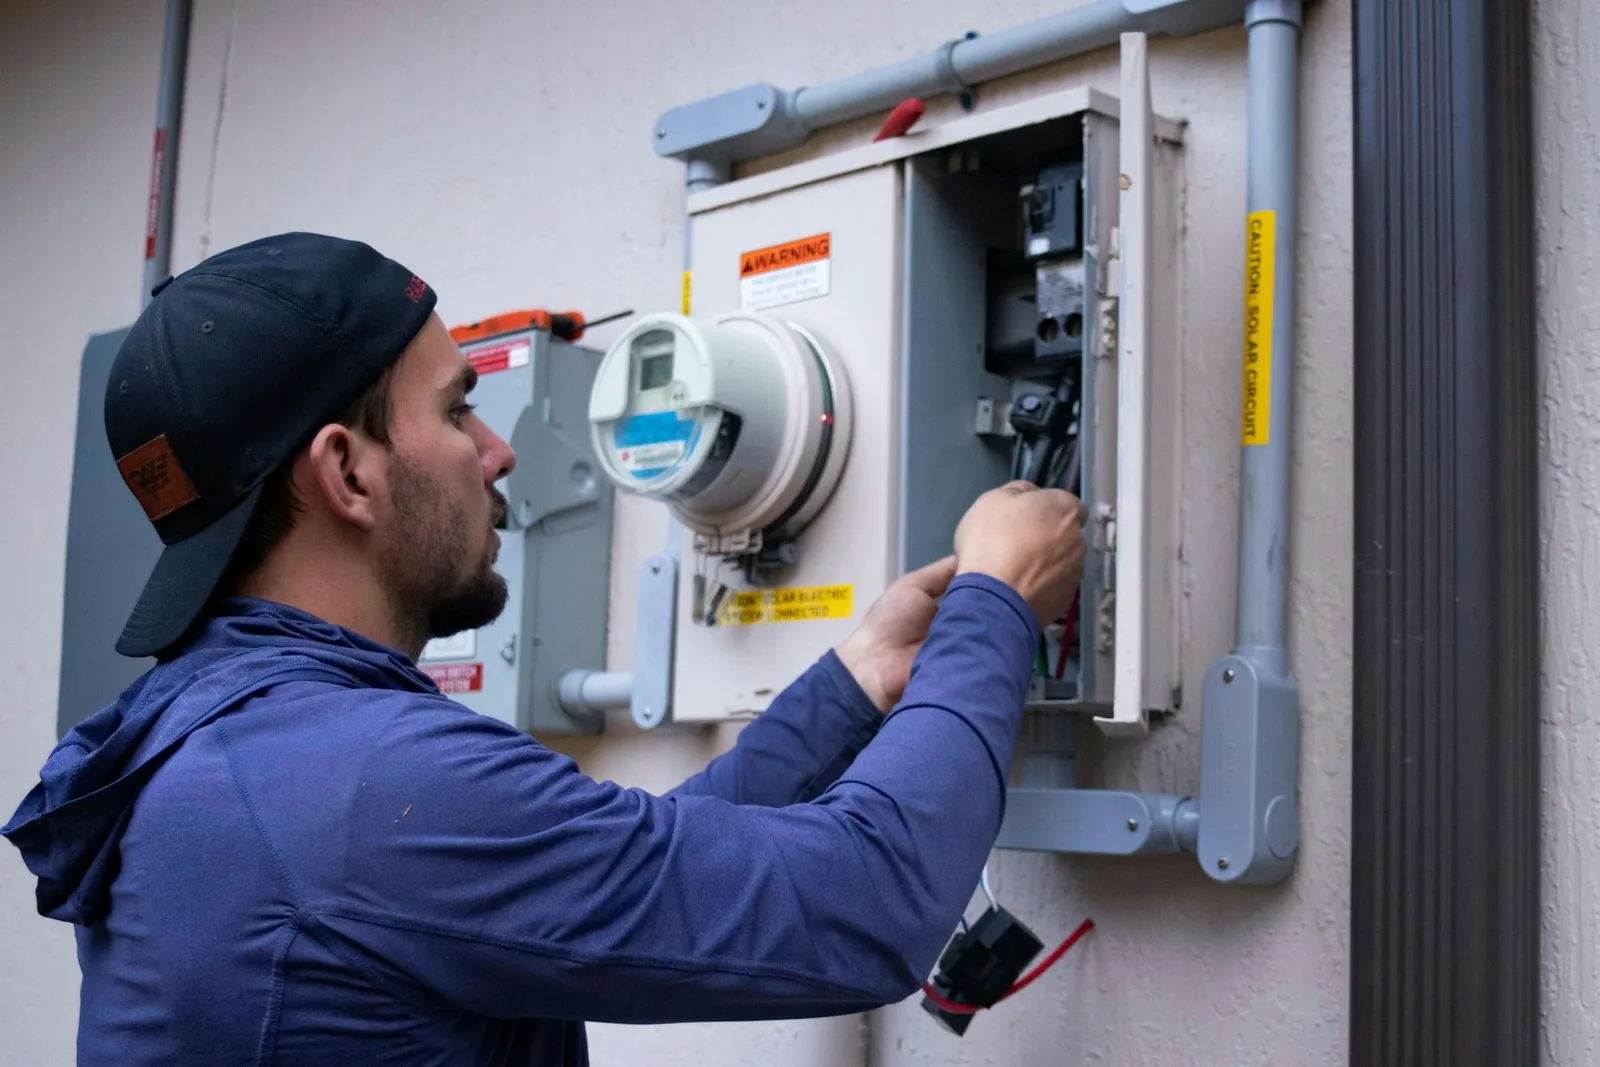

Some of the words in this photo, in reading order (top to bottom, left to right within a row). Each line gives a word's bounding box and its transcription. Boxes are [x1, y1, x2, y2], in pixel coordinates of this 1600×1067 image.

[755, 239, 829, 270] WARNING
[1247, 305, 1260, 364] SOLAR
[1244, 369, 1258, 437] CIRCUIT
